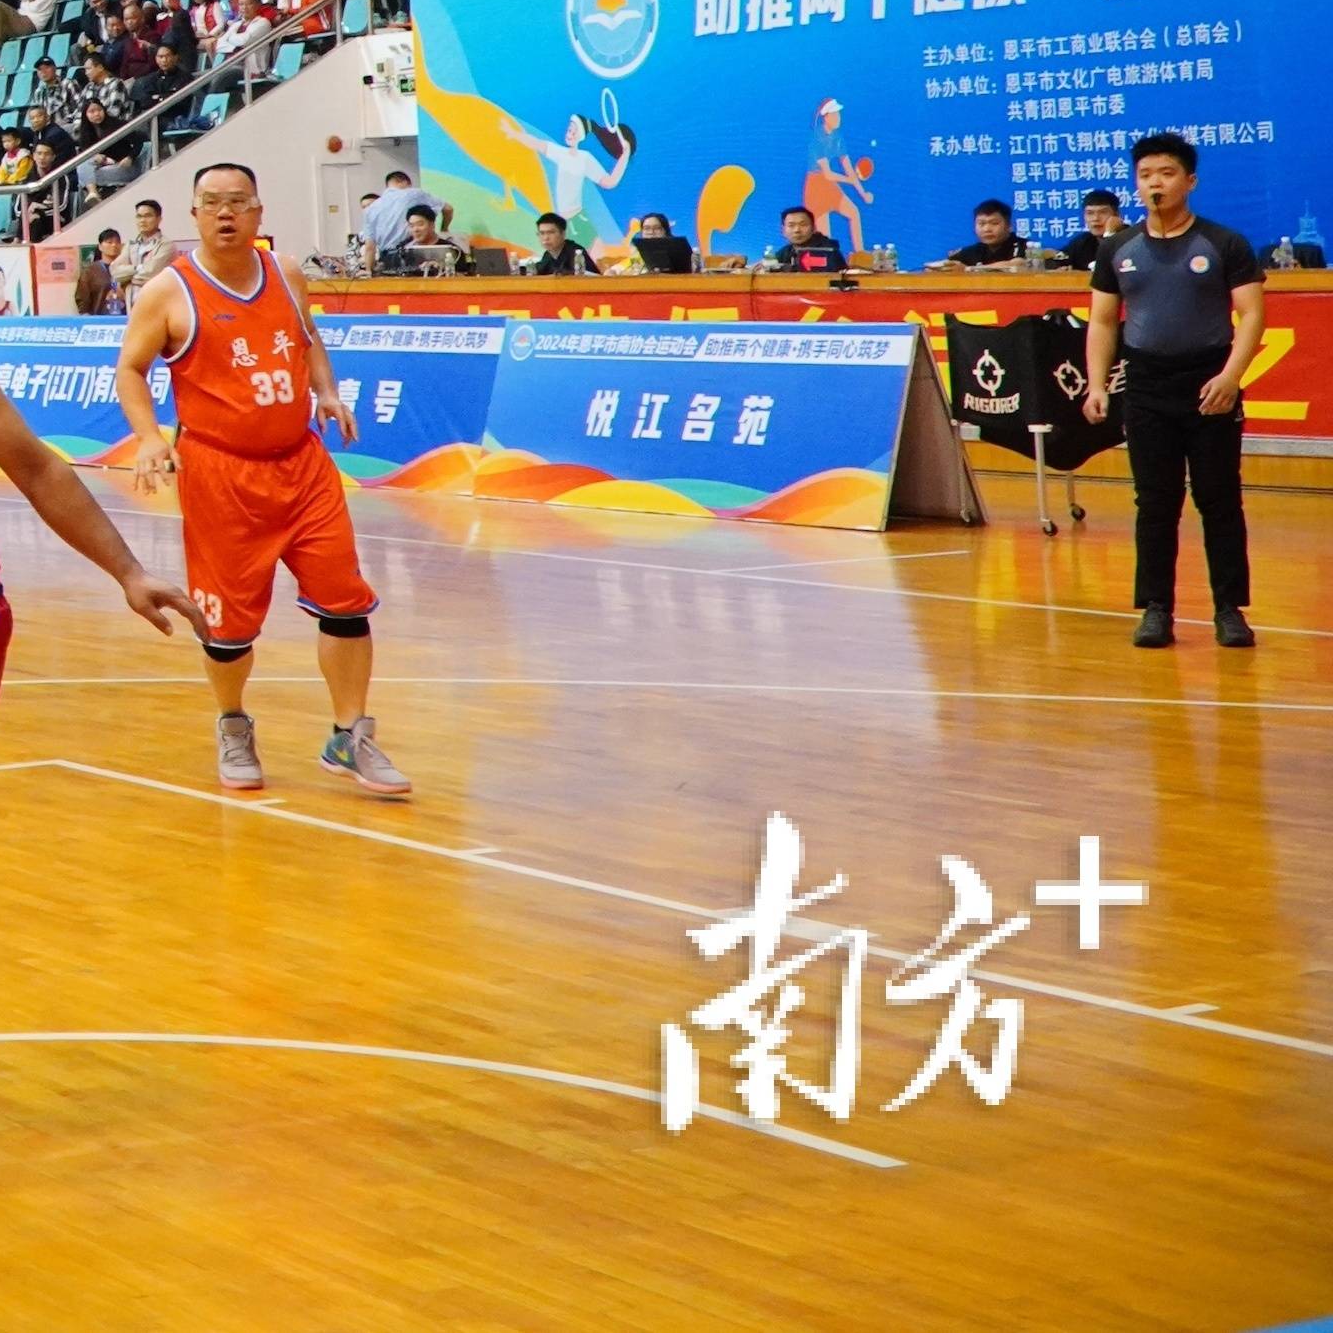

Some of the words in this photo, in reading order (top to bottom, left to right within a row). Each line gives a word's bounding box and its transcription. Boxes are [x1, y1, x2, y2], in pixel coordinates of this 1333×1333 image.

[1007, 93, 1125, 121] 共青团恩平市委
[1011, 157, 1129, 183] 恩平市篮球协会
[231, 329, 296, 369] 恩平
[536, 334, 699, 358] 2024年恩平市商协会运动会
[703, 337, 891, 360] 助推两个健康·携手同心筑梦
[250, 369, 295, 407] 33
[586, 389, 775, 446] 悦江名苑
[963, 392, 1021, 415] RIGORER
